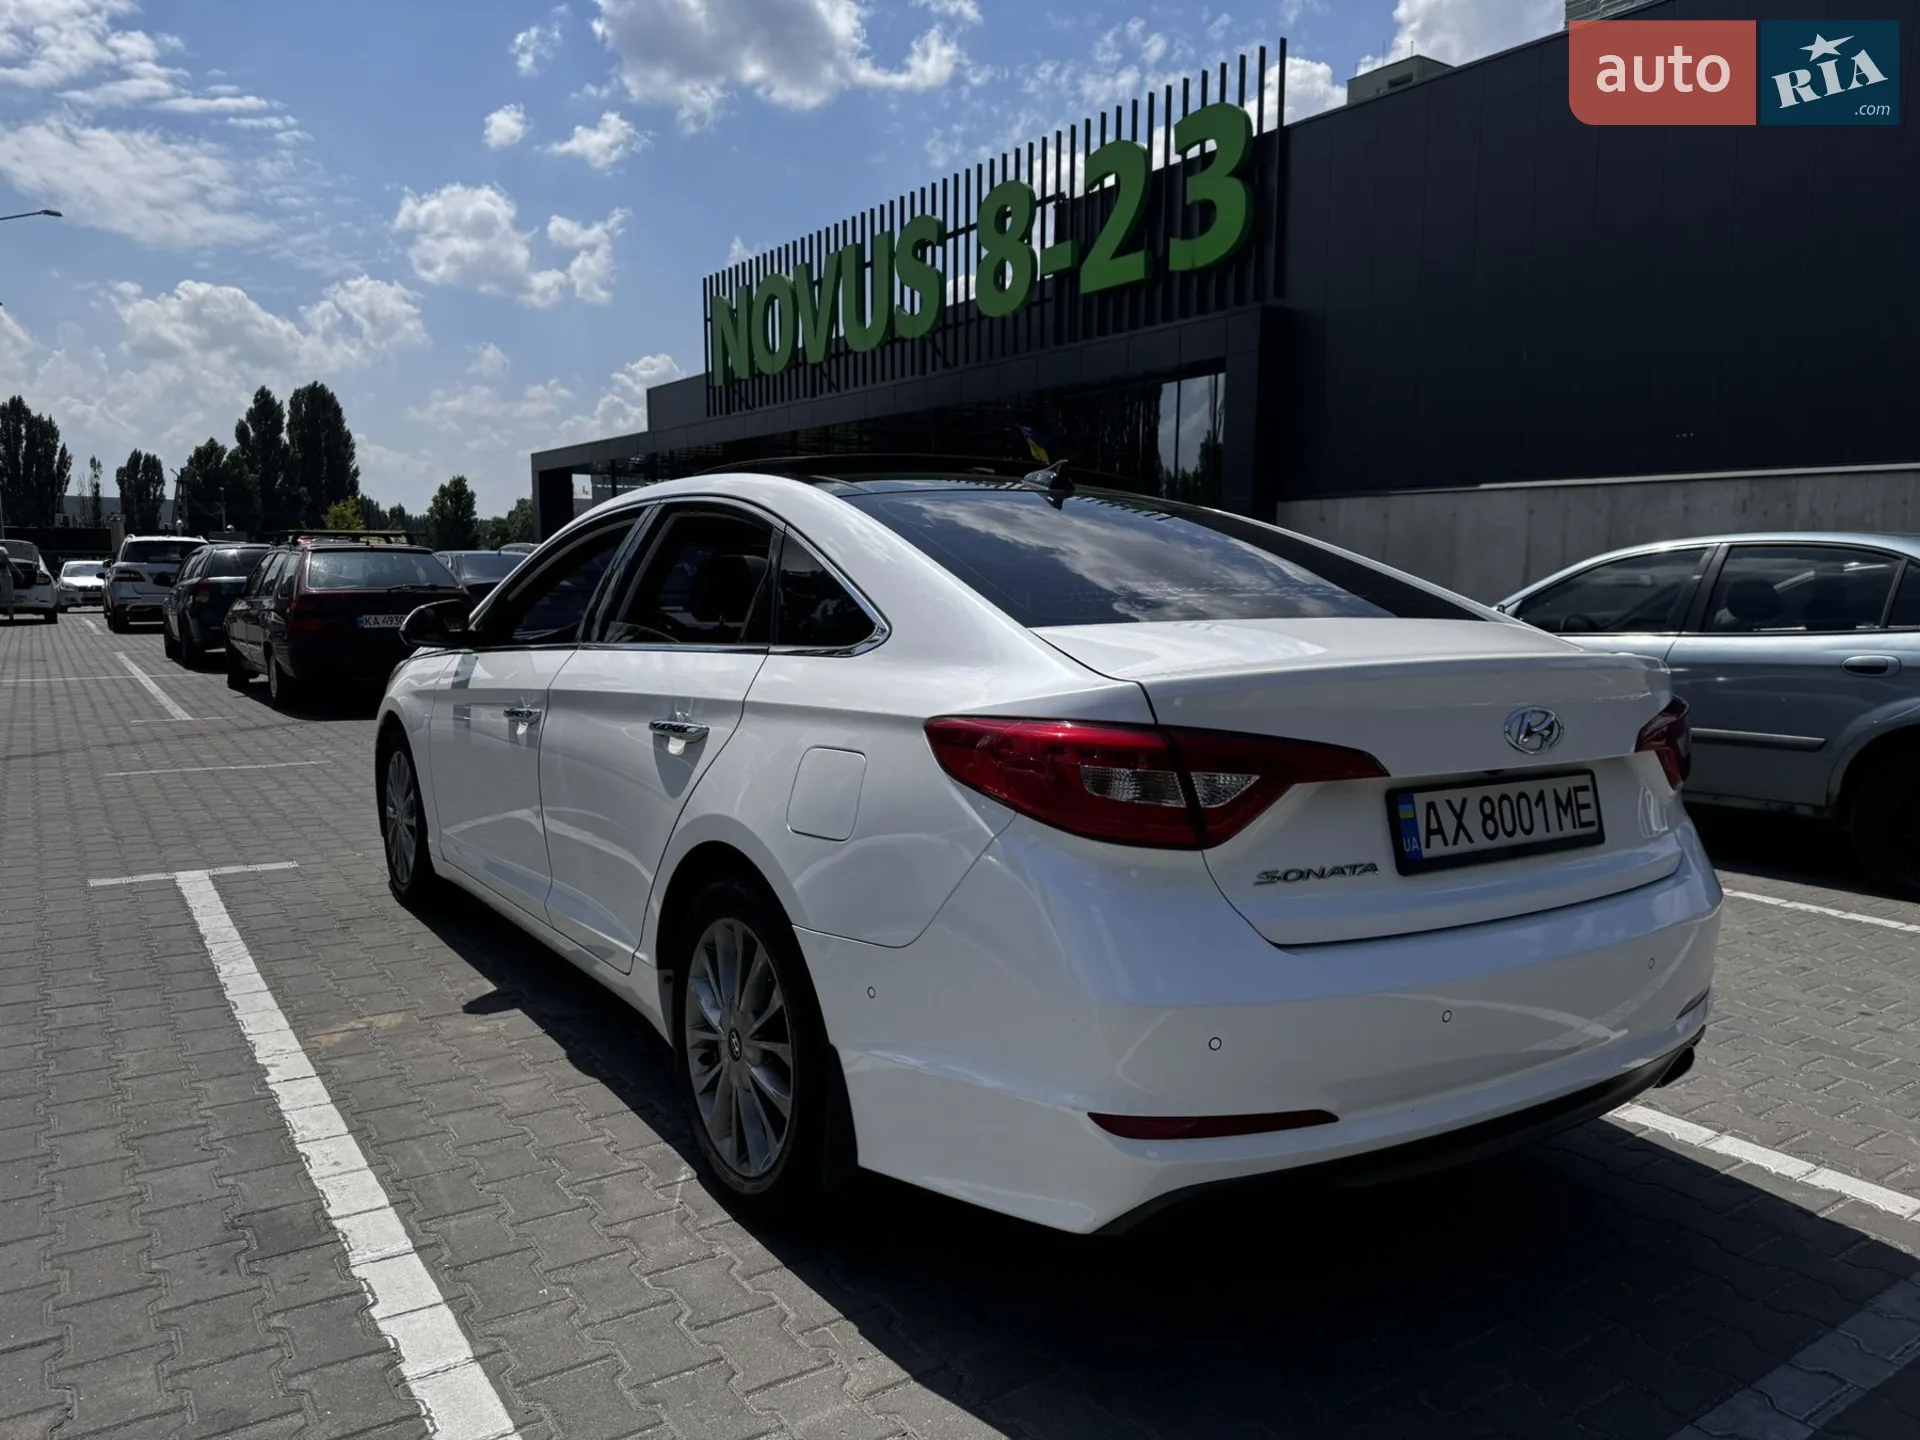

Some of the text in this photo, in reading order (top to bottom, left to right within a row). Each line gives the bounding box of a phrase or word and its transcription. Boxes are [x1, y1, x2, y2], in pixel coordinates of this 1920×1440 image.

[712, 101, 1254, 387] NOVUS 8-23
[364, 615, 380, 626] KA
[1425, 784, 1596, 849] AX 8001 ME
[1402, 836, 1421, 851] UA
[1252, 862, 1380, 886] SONATA
